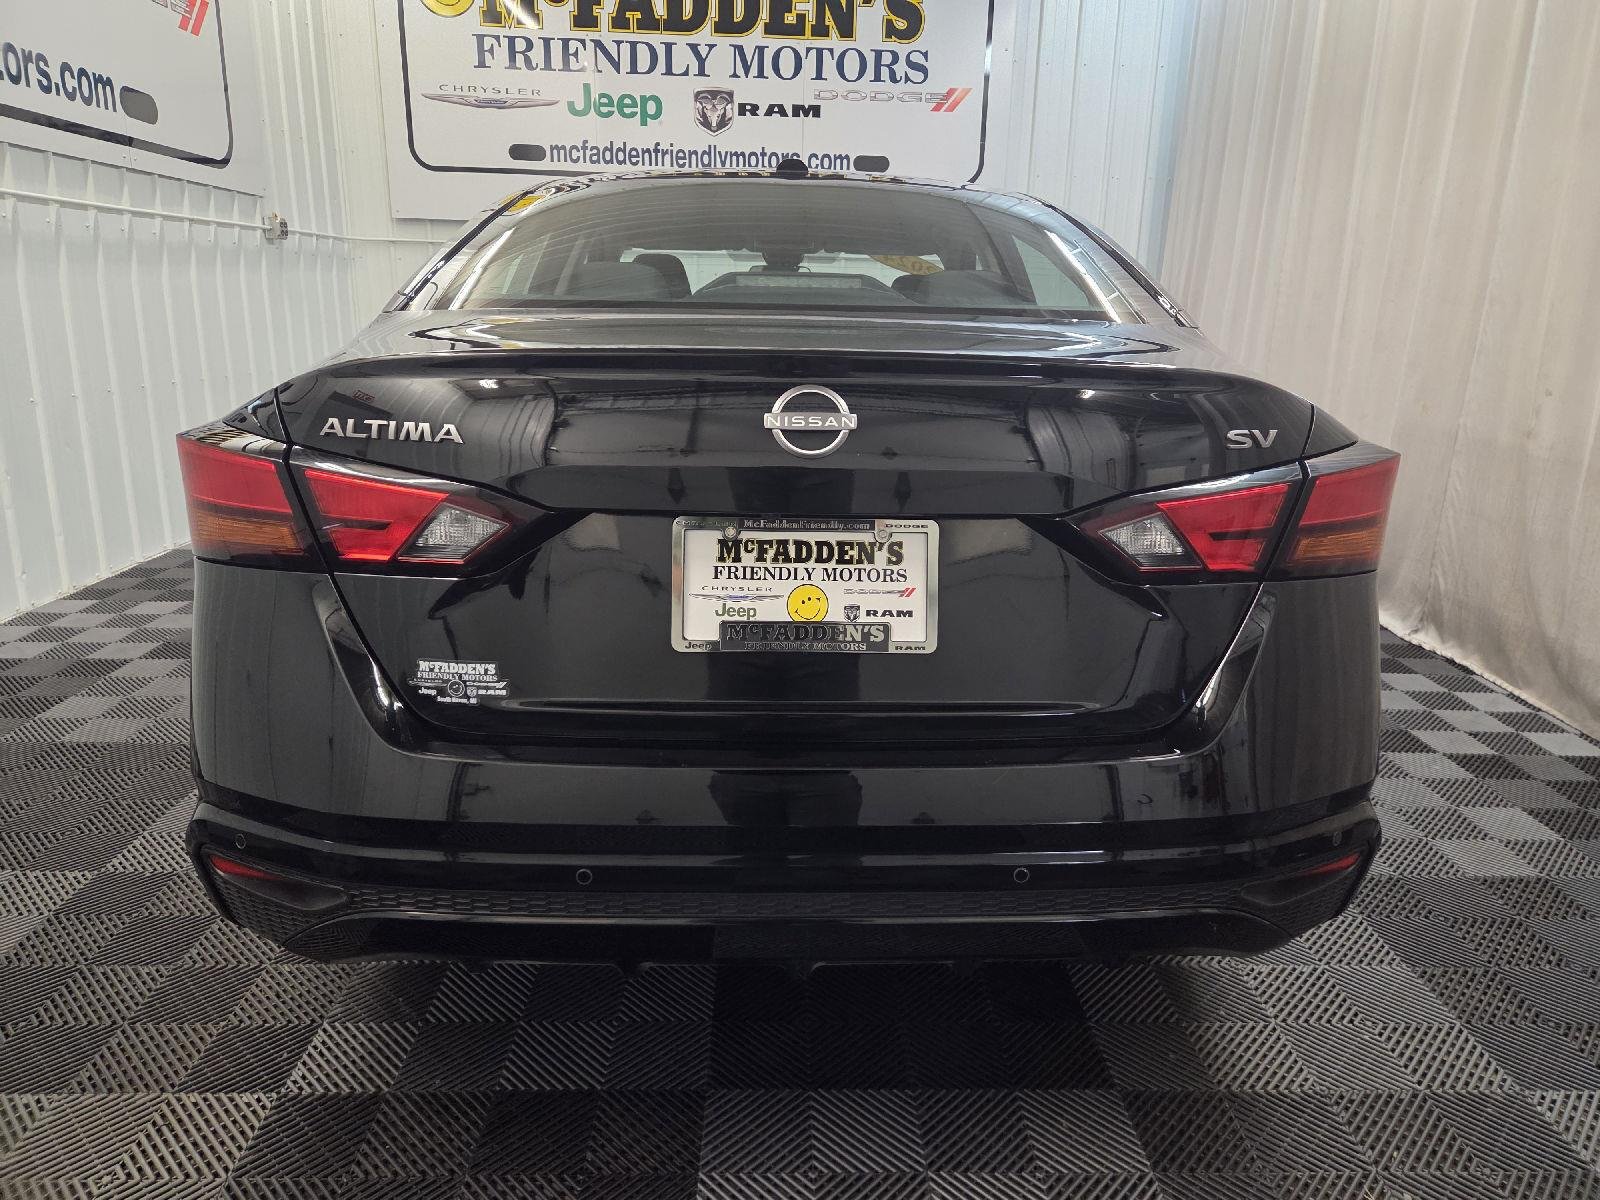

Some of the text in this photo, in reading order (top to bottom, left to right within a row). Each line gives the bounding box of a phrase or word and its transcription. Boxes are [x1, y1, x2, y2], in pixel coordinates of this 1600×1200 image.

[472, 33, 929, 85] FRIENDLY MOTORS
[0, 42, 117, 112] ors.com
[439, 84, 541, 96] CHRYSLER
[813, 88, 949, 103] DODGE
[567, 83, 663, 126] Jeep
[737, 102, 821, 118] RAM
[767, 415, 855, 428] NISSAN
[319, 417, 464, 444] ALTIMA
[1226, 429, 1278, 449] SV
[743, 519, 871, 531] McFaddenFriendly.com
[716, 538, 904, 566] McFADDEN'S
[712, 565, 908, 583] FRIENDLY MOTORS
[715, 603, 757, 620] Jeep
[865, 609, 914, 618] RAM
[726, 623, 885, 642] McFADDEN'S
[684, 641, 712, 651] Jeep
[813, 642, 867, 651] MOTORS
[417, 671, 460, 681] FRIENDLY
[461, 674, 498, 682] MOTORS
[418, 687, 437, 695] Jeep
